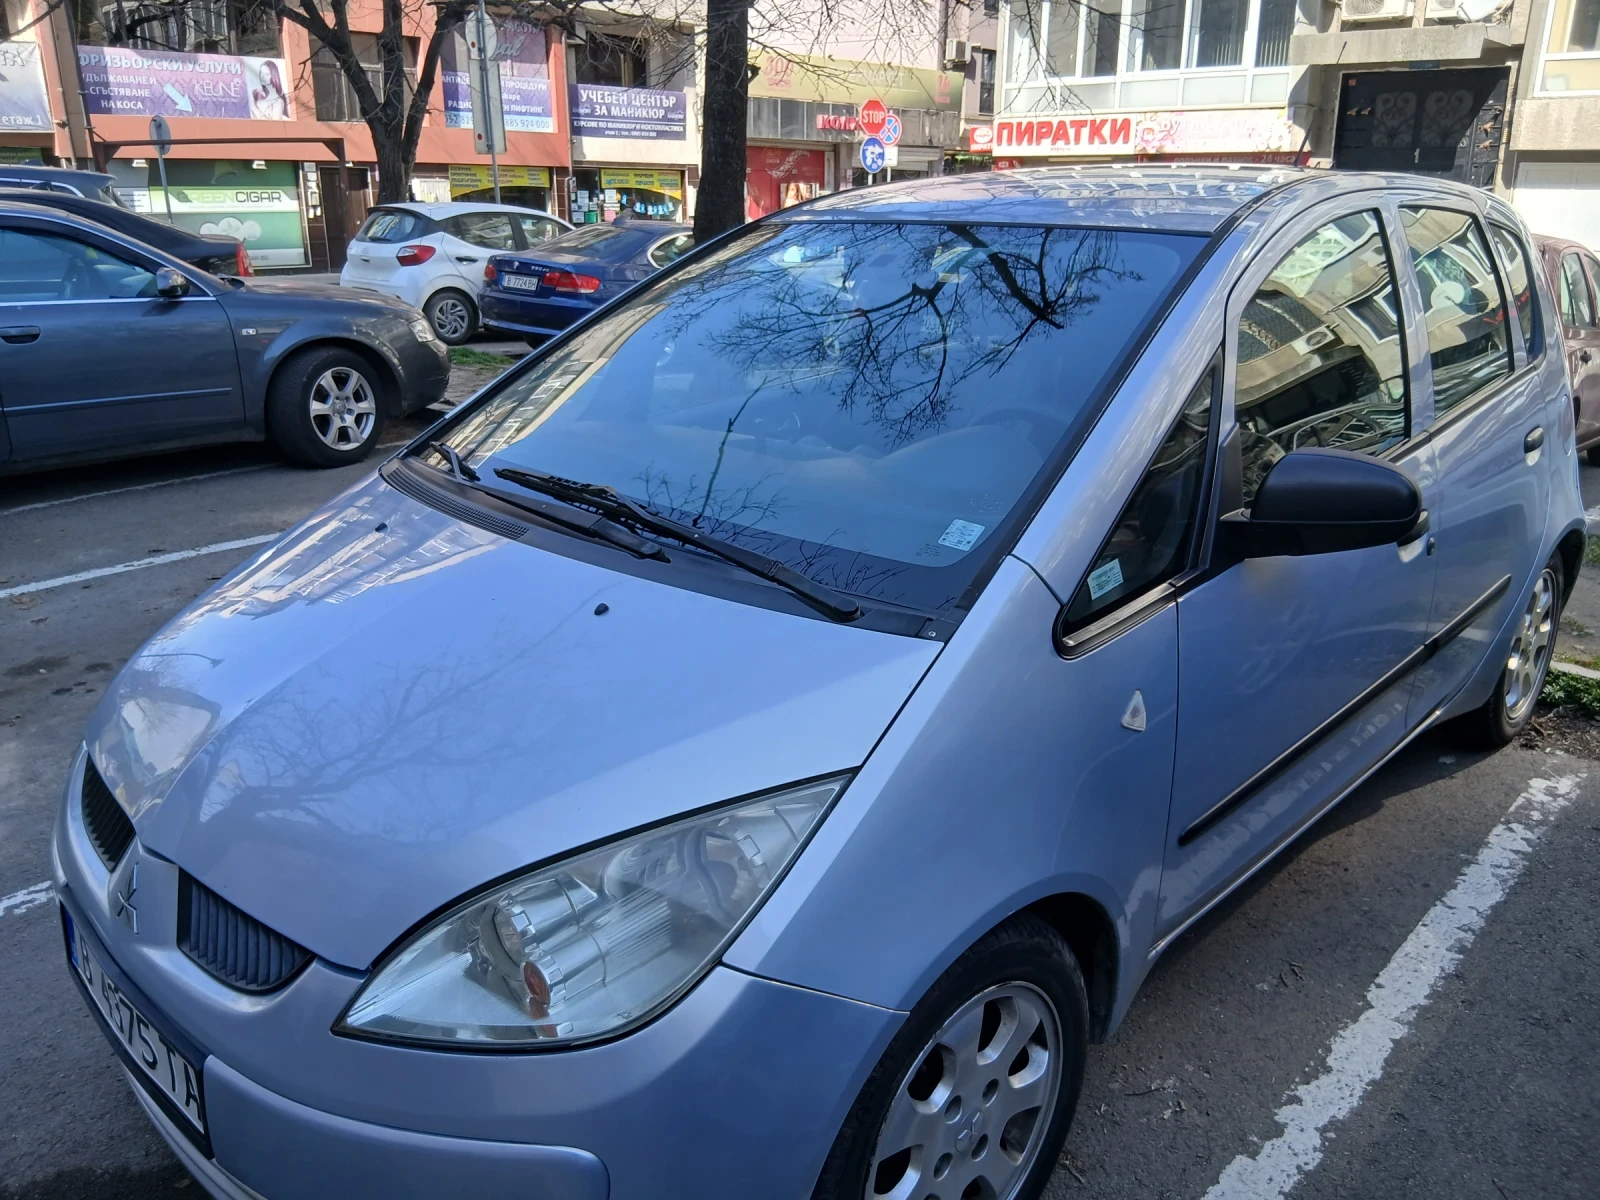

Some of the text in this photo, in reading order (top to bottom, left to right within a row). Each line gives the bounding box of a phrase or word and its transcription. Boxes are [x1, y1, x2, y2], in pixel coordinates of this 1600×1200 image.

[79, 53, 242, 75] ФРИЗЬОРСКИ УСЛУГИ
[82, 73, 157, 84] ДЪЛЖАВАНЕ И
[89, 86, 150, 97] СГЪСТЯВАНЕ
[194, 79, 241, 97] KEUNE
[101, 99, 143, 109] НА КОСА
[579, 89, 677, 108] УЧЕБЕН ЦЕНТЪР
[593, 104, 608, 116] ЗА
[610, 106, 666, 119] МАНИКЮР
[863, 110, 885, 124] STOP
[2, 114, 43, 125] етаж 1
[520, 119, 534, 128] 924
[535, 120, 550, 129] 000
[996, 118, 1131, 146] ПИРАТКИ
[158, 1033, 202, 1123] TA
